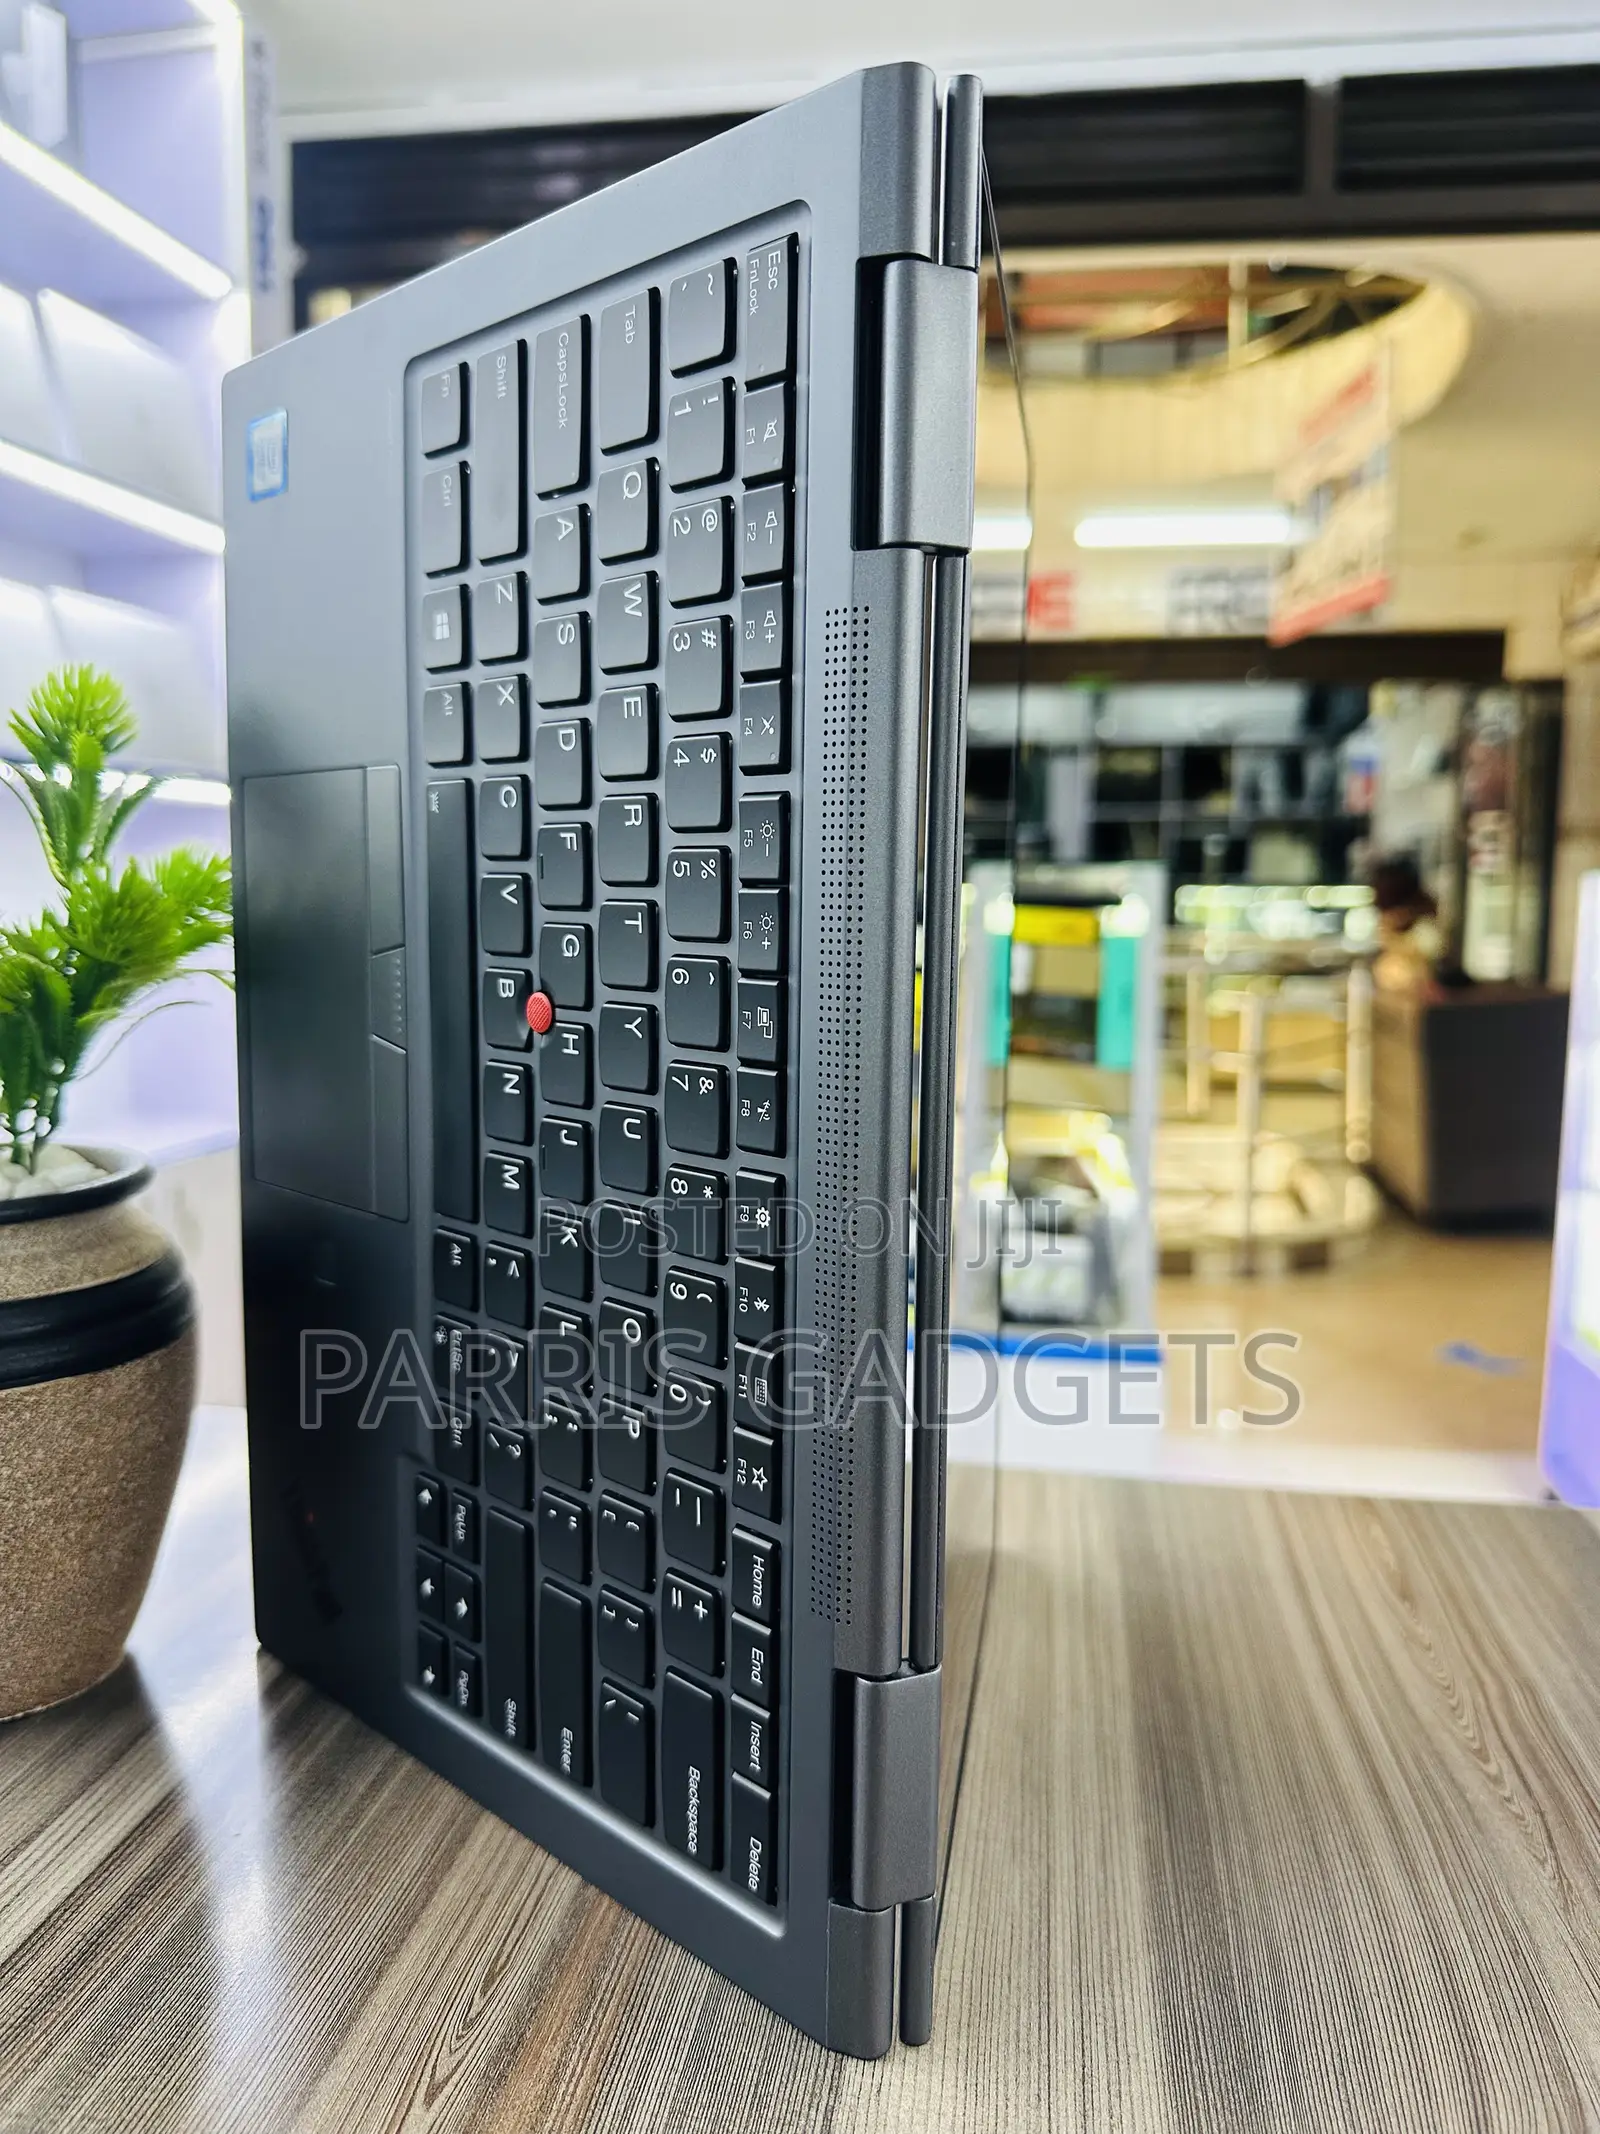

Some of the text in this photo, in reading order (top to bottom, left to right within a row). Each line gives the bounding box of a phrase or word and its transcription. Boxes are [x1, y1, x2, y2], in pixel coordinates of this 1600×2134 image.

[767, 249, 781, 290] Esc
[749, 258, 760, 315] FnLock
[624, 305, 636, 344] Tab
[441, 374, 451, 398] Fn
[496, 355, 507, 399] Shift
[557, 332, 569, 429] CapsLock
[674, 401, 692, 417] 1
[746, 427, 755, 446] F1
[443, 474, 452, 508] Ctrl
[622, 470, 642, 501] Q
[556, 517, 575, 541] A
[673, 520, 691, 537] 2
[701, 508, 718, 532] @
[747, 522, 756, 542] F2
[497, 583, 513, 604] Z
[623, 582, 643, 618] W
[557, 623, 575, 645] S
[701, 629, 717, 649] #
[746, 620, 755, 640] F3
[673, 633, 691, 651] 3
[498, 683, 515, 706] X
[623, 696, 642, 719] E
[743, 717, 753, 736] F4
[558, 728, 576, 752] D
[673, 748, 690, 767] 4
[700, 748, 717, 764] $
[500, 785, 517, 809] C
[624, 804, 642, 826] R
[559, 831, 577, 851] F
[743, 829, 753, 848] F5
[673, 860, 690, 878] 5
[700, 859, 717, 880] %
[500, 883, 518, 905] V
[624, 912, 643, 933] T
[743, 921, 753, 940] F6
[561, 934, 580, 958] G
[672, 968, 690, 985] 6
[499, 978, 515, 998] B
[624, 1016, 643, 1039] Y
[741, 1010, 751, 1030] F7
[561, 1033, 579, 1055] H
[502, 1073, 520, 1095] N
[671, 1074, 689, 1092] 7
[699, 1076, 714, 1095] &
[741, 1099, 751, 1117] F8
[559, 1129, 578, 1147] J
[623, 1118, 641, 1140] U
[500, 1165, 520, 1190] M
[670, 1177, 689, 1195] 8
[739, 1205, 750, 1223] F9
[559, 1225, 578, 1248] K
[669, 1282, 688, 1300] 9
[738, 1286, 749, 1313] F10
[559, 1320, 577, 1336] L
[622, 1318, 642, 1344] O
[738, 1373, 747, 1399] F11
[621, 1415, 640, 1440] P
[737, 1457, 747, 1485] F12
[751, 1554, 765, 1609] Home
[751, 1646, 764, 1685] End
[503, 1698, 517, 1738] Shift
[560, 1727, 574, 1776] Enter
[748, 1720, 763, 1773] Insert
[685, 1765, 700, 1855] Backspace
[747, 1836, 762, 1892] Delete
